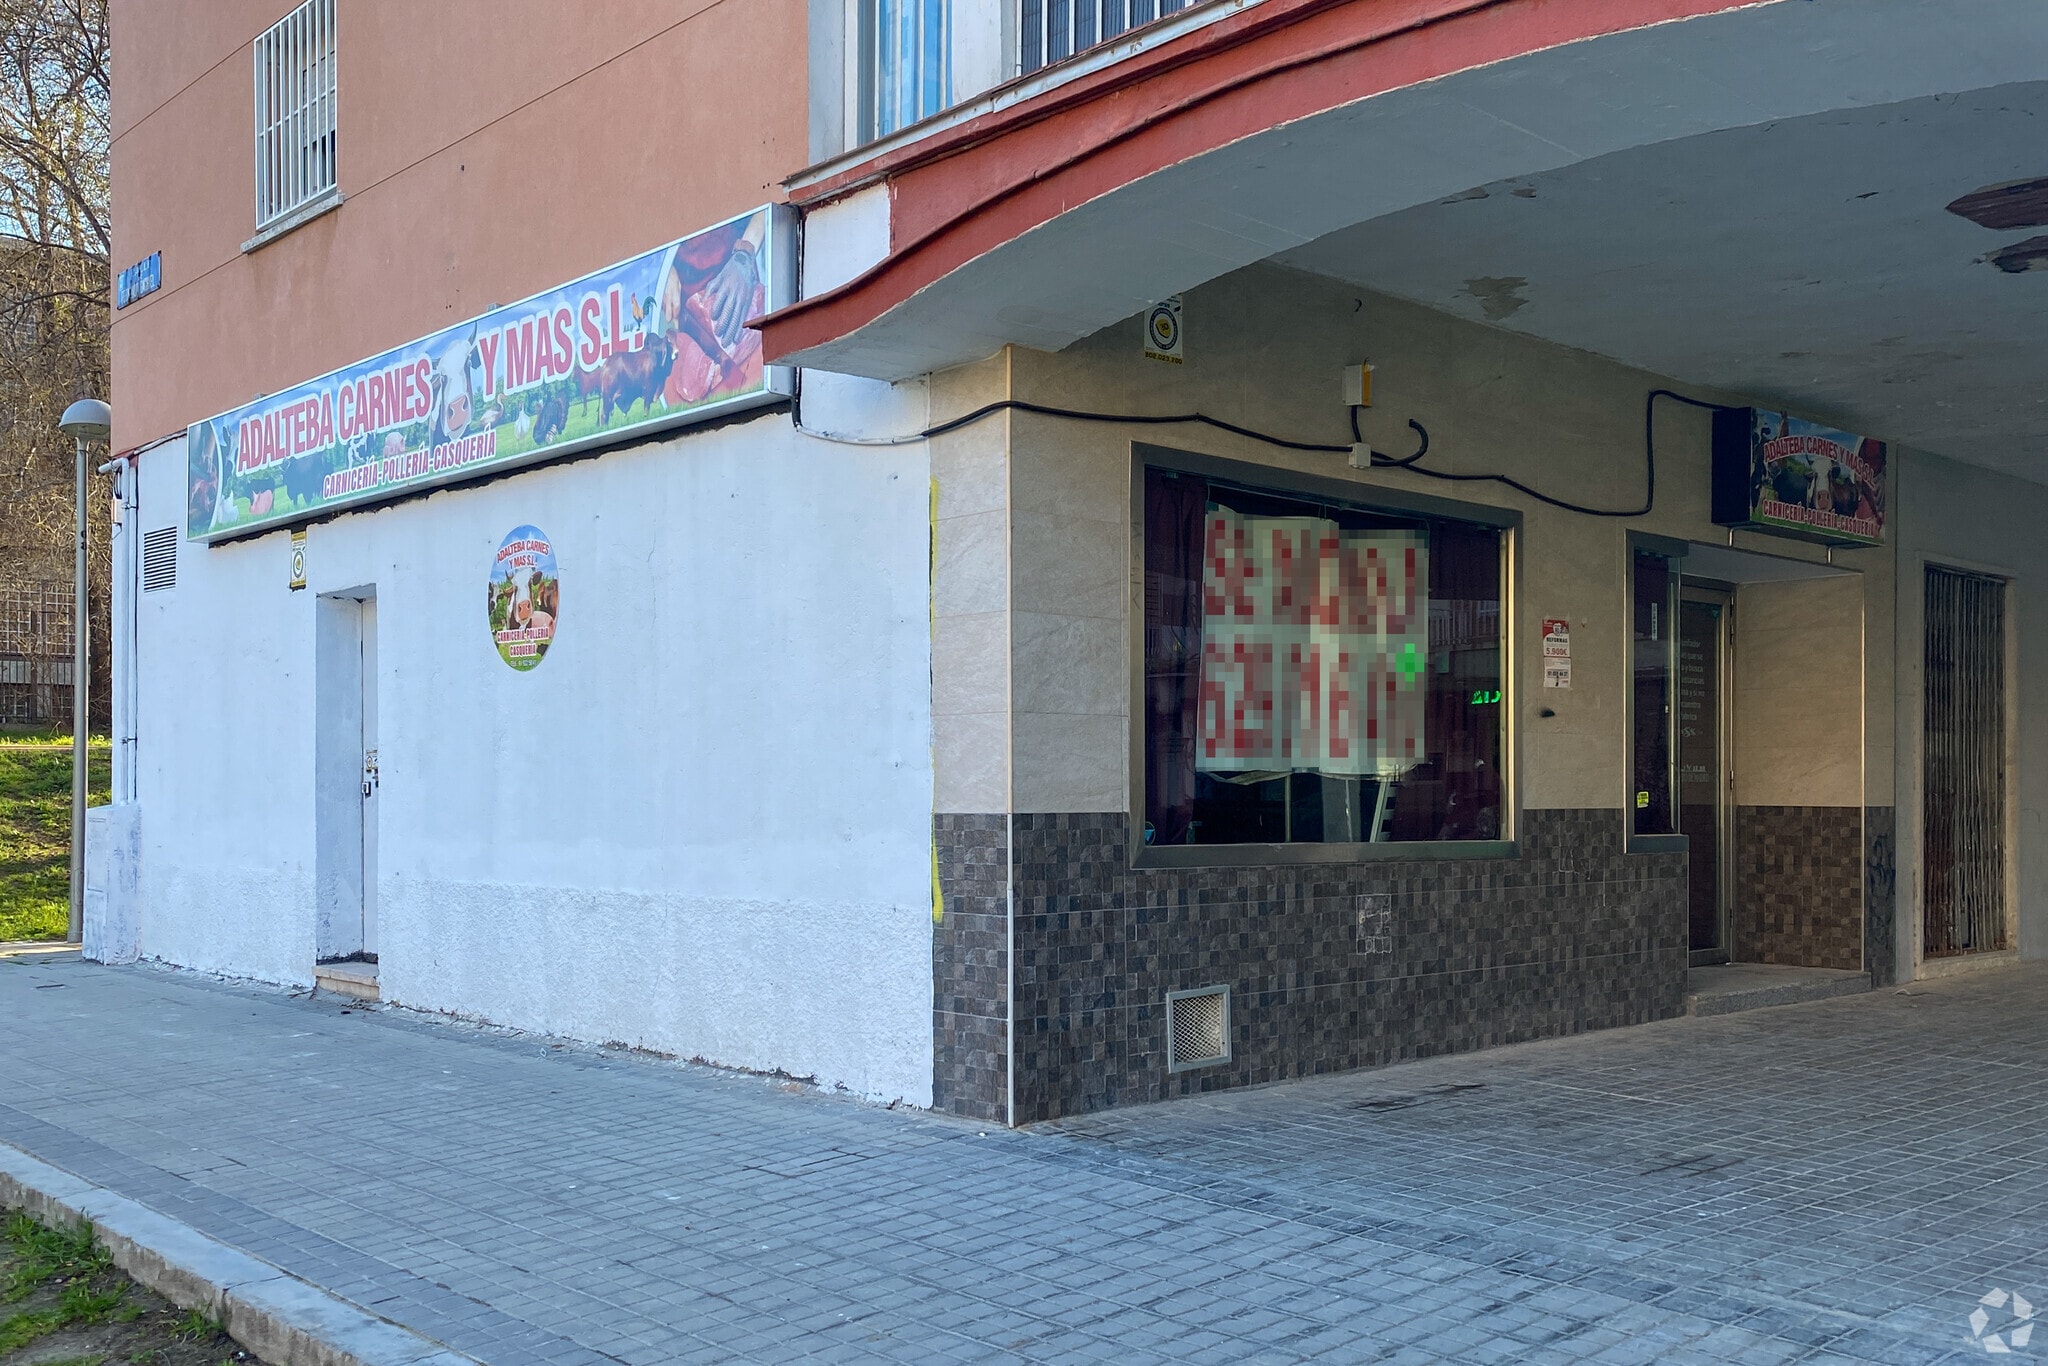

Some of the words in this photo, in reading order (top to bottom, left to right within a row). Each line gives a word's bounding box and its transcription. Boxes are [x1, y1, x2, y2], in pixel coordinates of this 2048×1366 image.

[238, 393, 333, 472] ADALTEBA
[339, 359, 431, 440] CARNES
[479, 333, 499, 396] Y
[506, 308, 573, 390] MAS
[580, 290, 644, 366] S.L.
[1764, 436, 1805, 462] ADALTEBA
[1807, 437, 1838, 460] CARNES
[1840, 446, 1846, 463] Y
[1846, 453, 1864, 475] MAS
[497, 541, 525, 563] ADALTEBA
[526, 540, 550, 556] CARNES
[509, 560, 514, 569] Y
[514, 557, 526, 568] MAS
